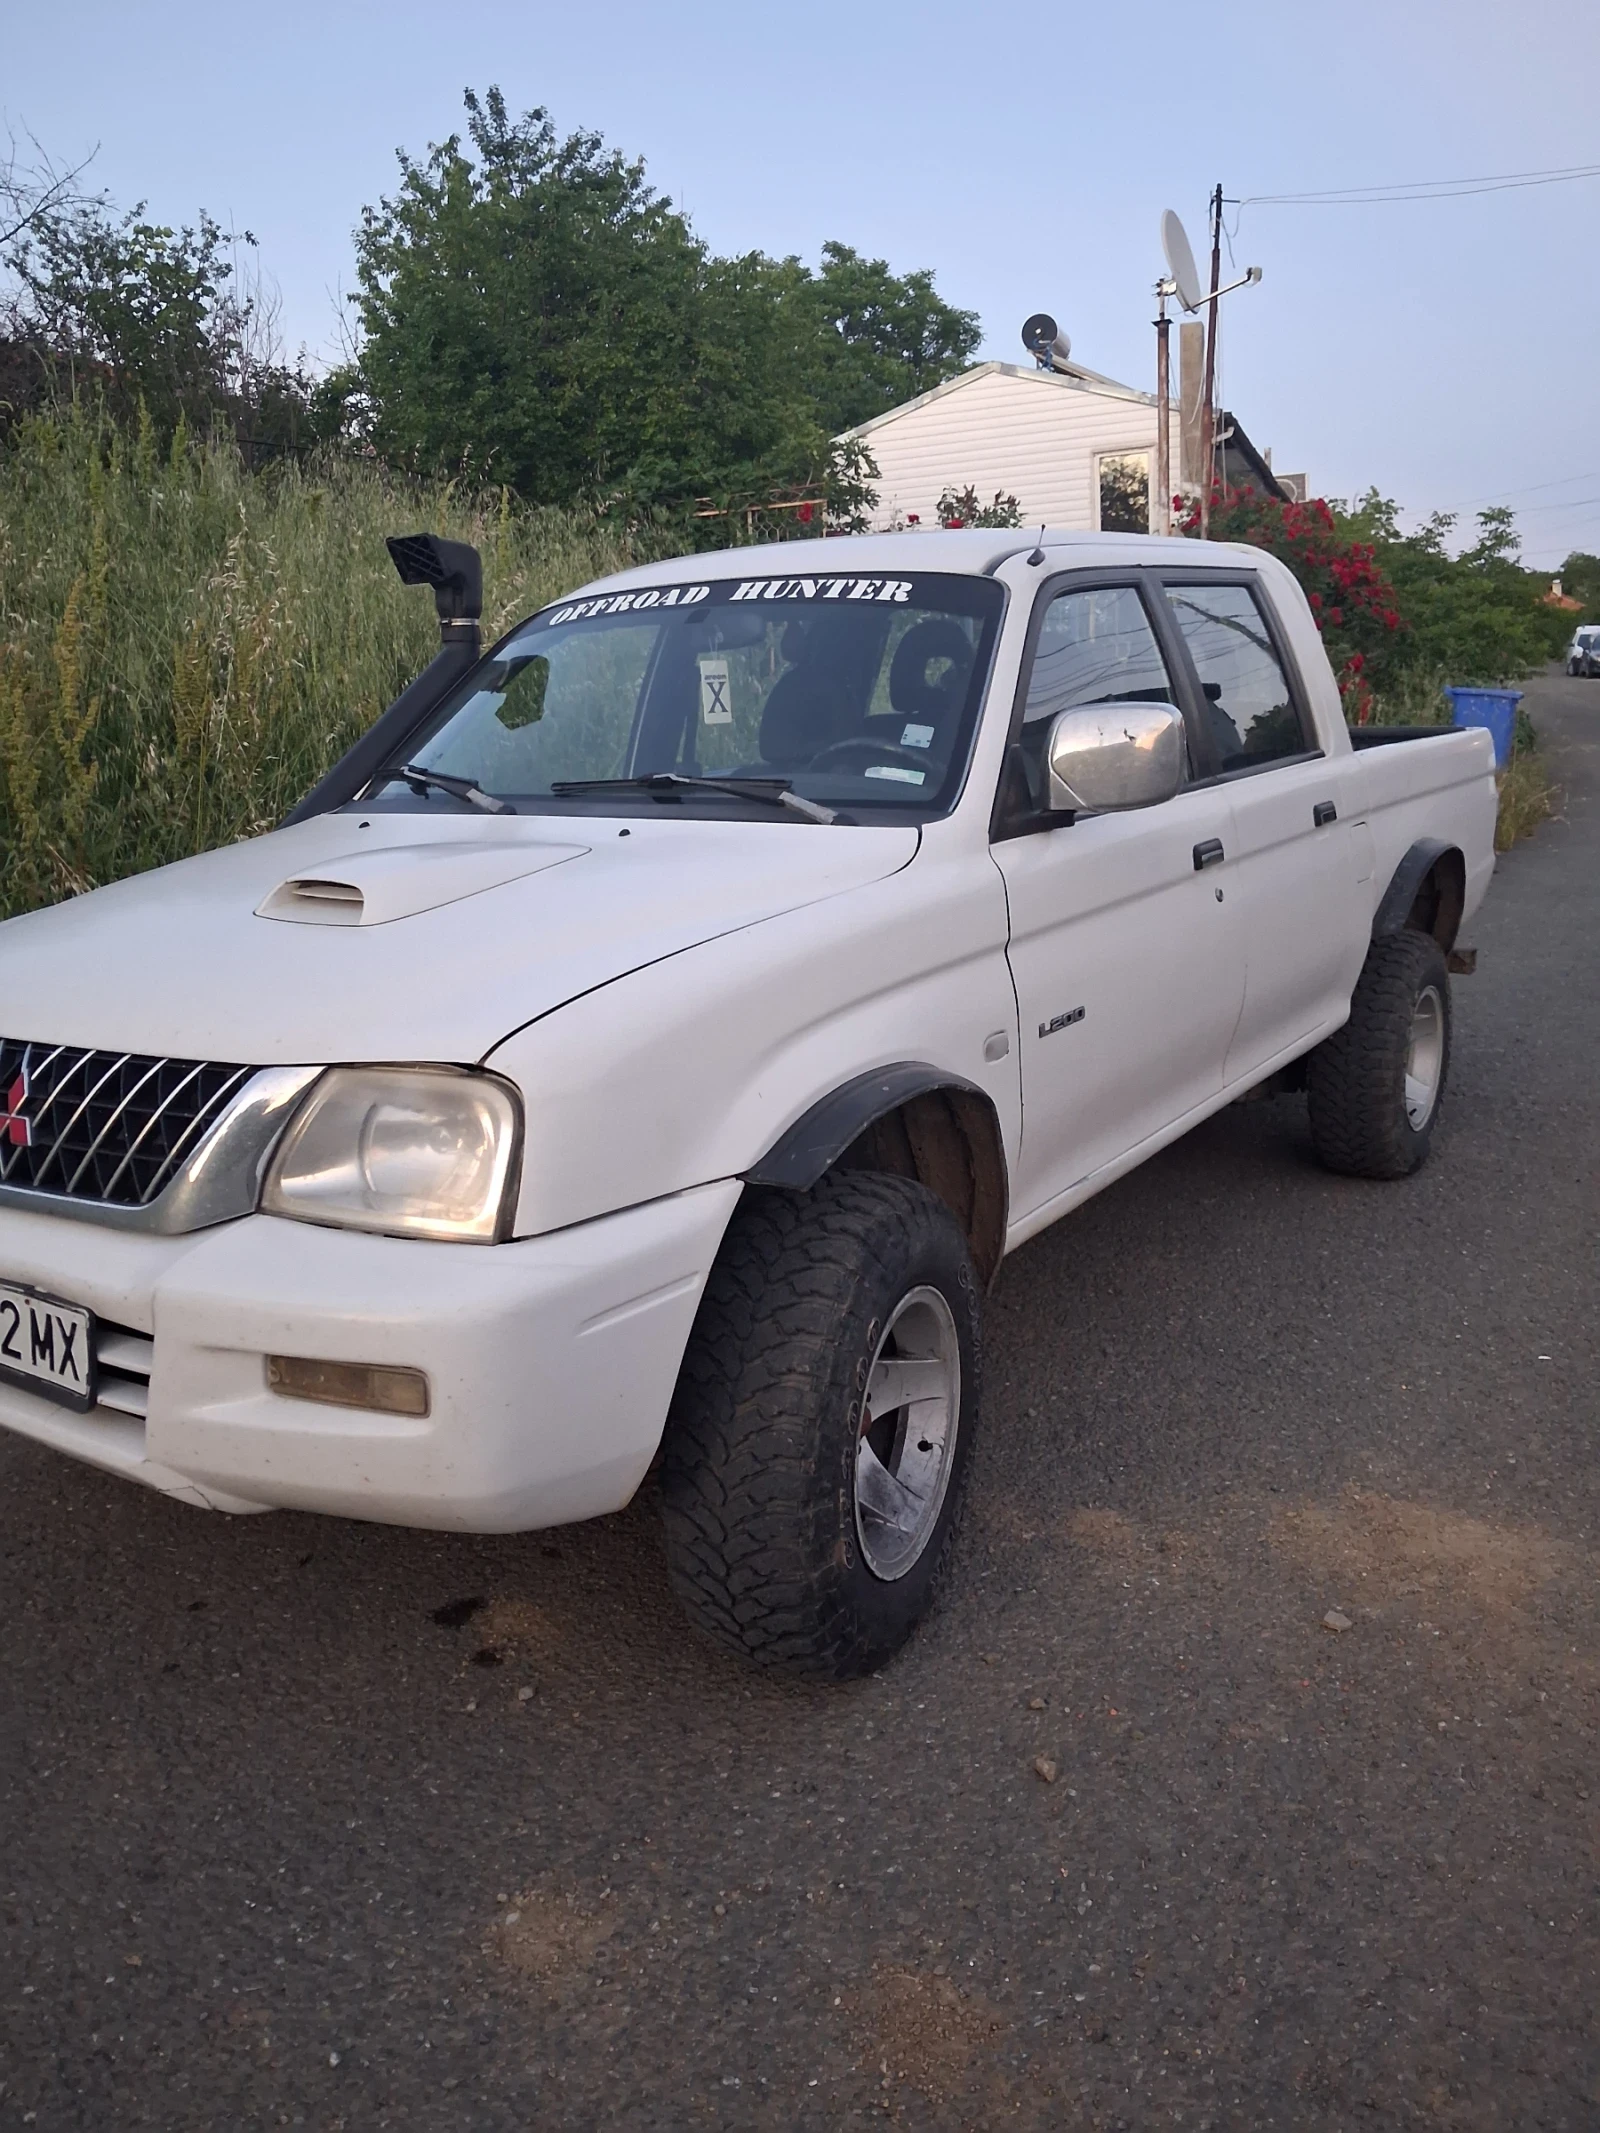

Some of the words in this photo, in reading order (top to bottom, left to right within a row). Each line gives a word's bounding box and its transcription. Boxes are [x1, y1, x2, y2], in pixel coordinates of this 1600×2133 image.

[549, 586, 711, 626] OFFROAD
[729, 579, 913, 602] HUNTER
[706, 681, 729, 714] X
[1039, 1005, 1086, 1039] L200
